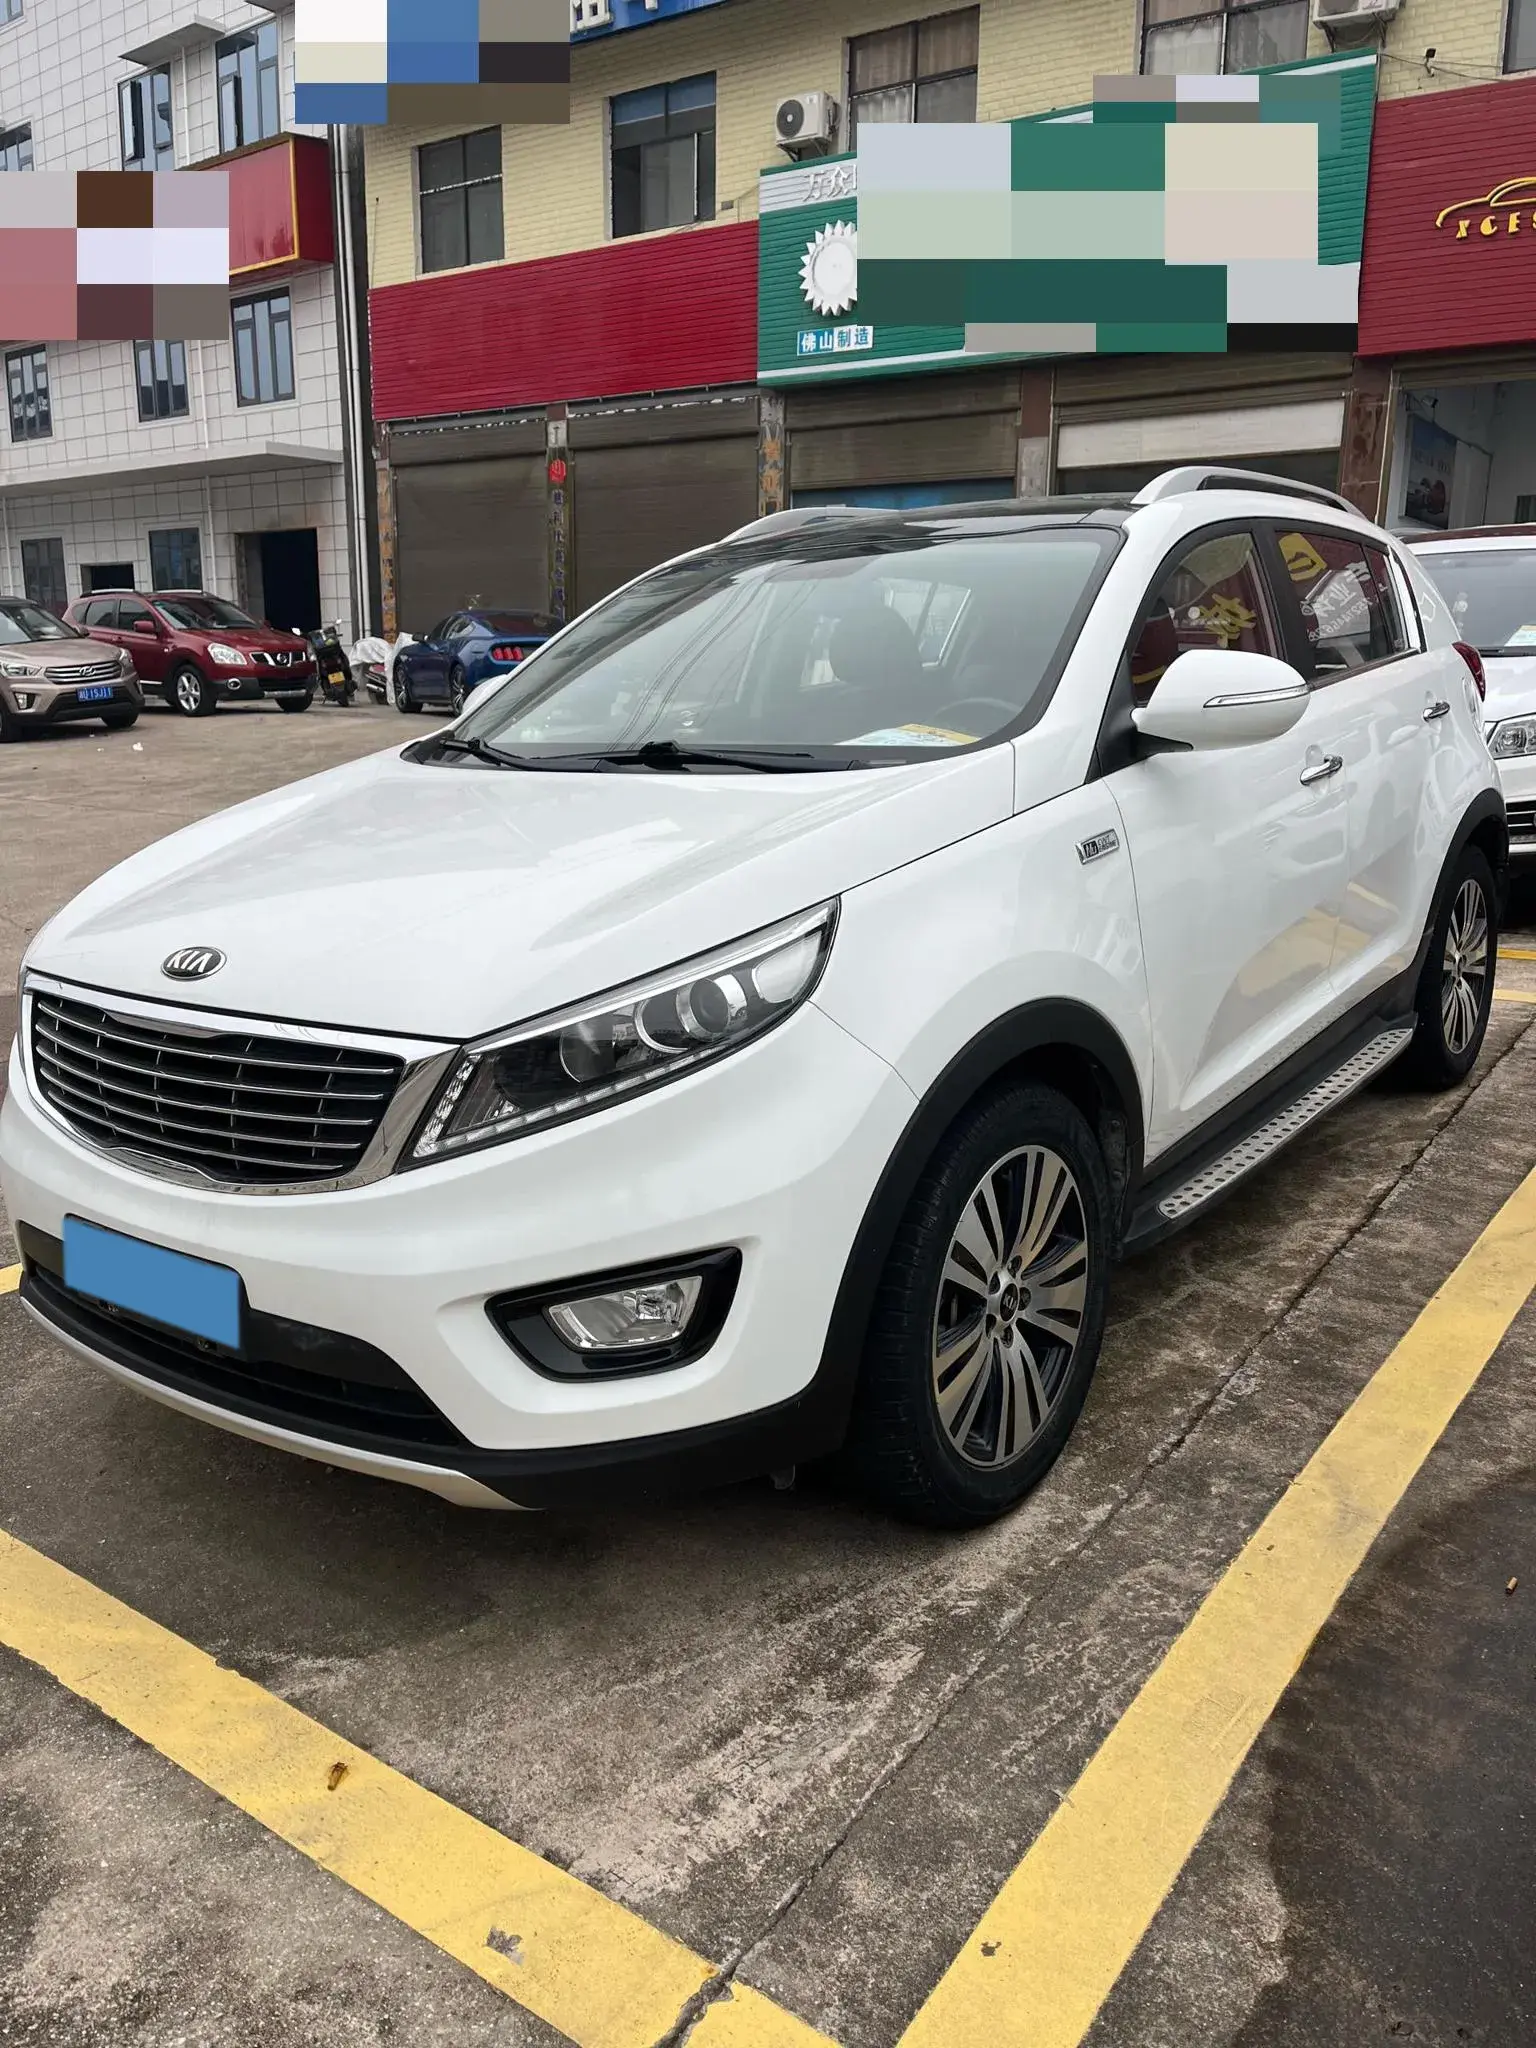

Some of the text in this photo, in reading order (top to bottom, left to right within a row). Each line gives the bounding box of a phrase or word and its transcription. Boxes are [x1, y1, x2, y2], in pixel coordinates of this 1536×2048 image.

[803, 164, 857, 202] 万众
[801, 327, 869, 352] 佛山制造
[166, 950, 213, 973] KIA
